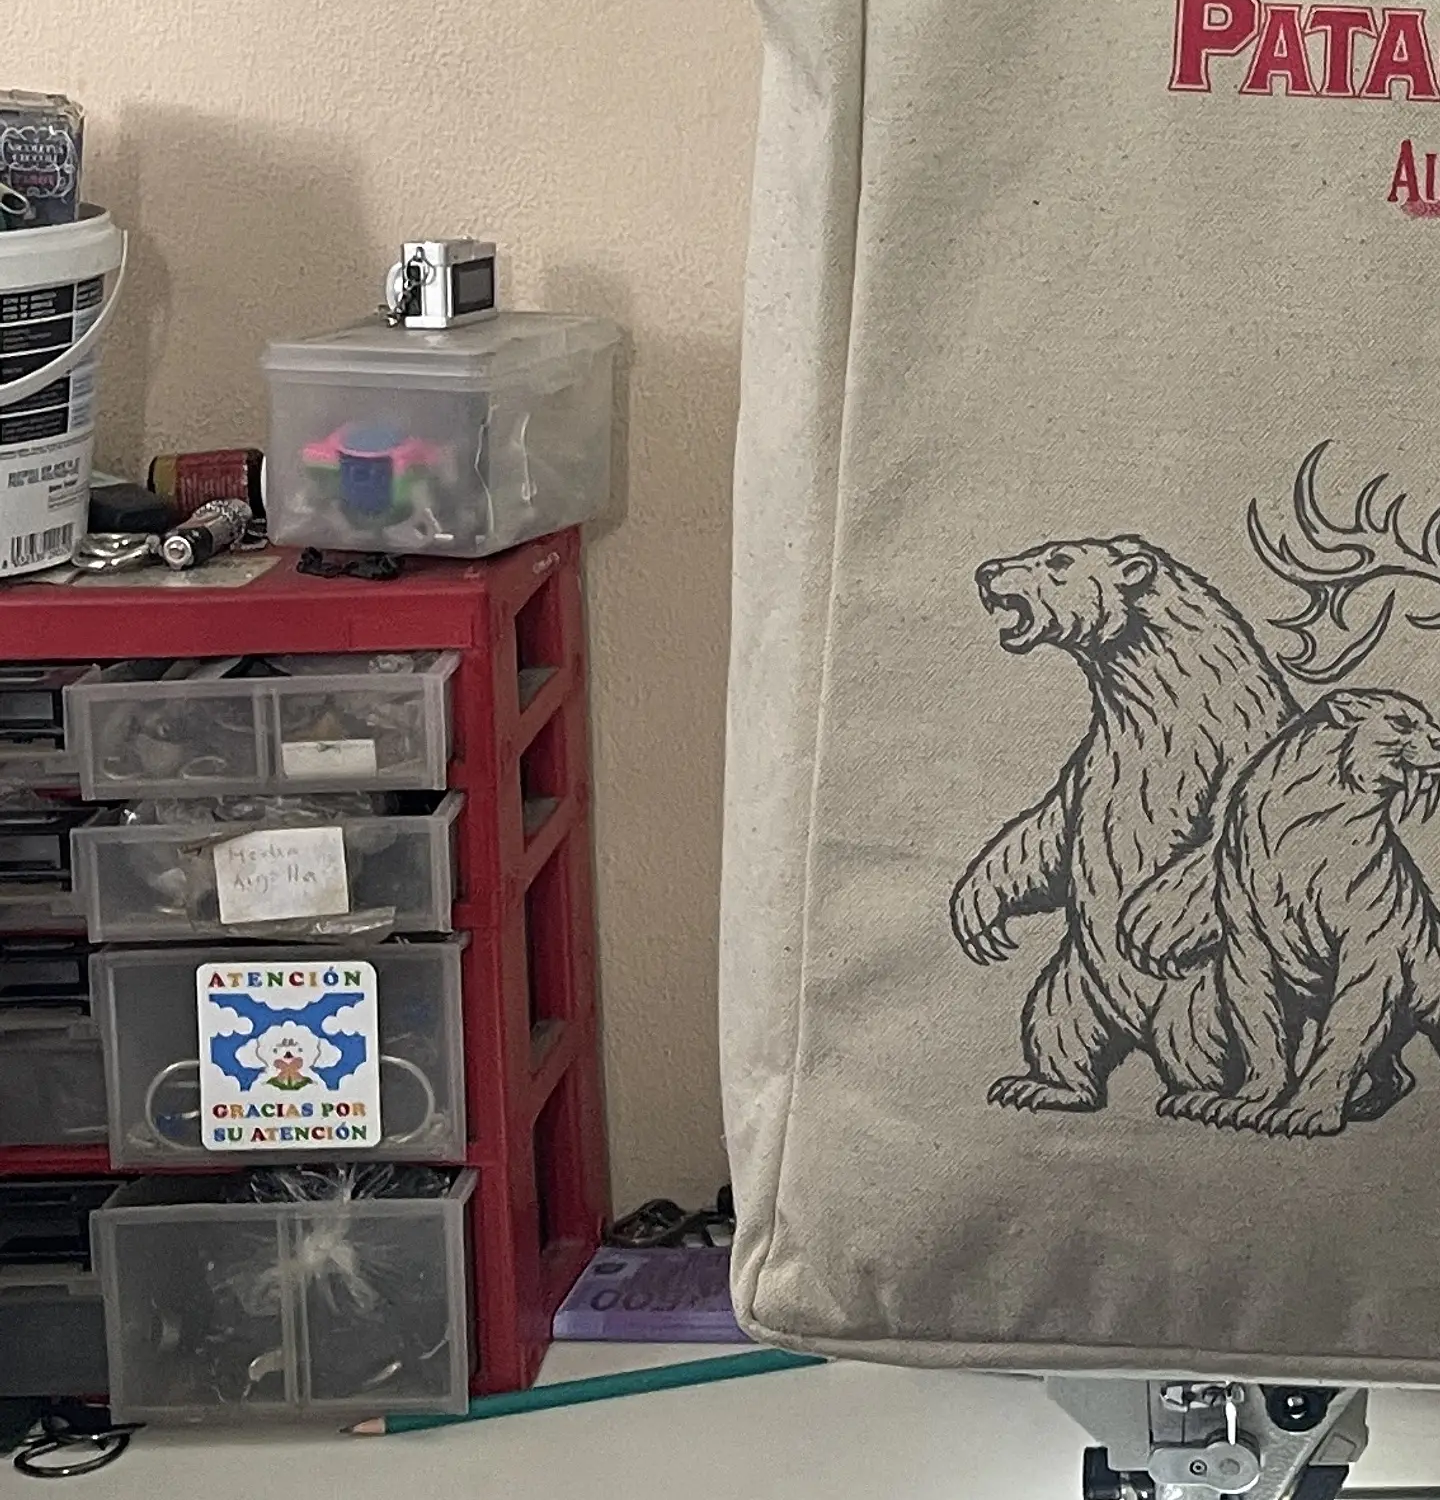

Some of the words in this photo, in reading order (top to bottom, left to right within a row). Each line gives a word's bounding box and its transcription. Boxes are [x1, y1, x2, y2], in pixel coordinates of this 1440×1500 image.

[208, 966, 362, 988] ATENCIÓN
[212, 1102, 314, 1119] GRACIAS
[320, 1102, 367, 1118] POR
[213, 1126, 243, 1143] SU
[250, 1122, 368, 1143] ATENCIÓN
